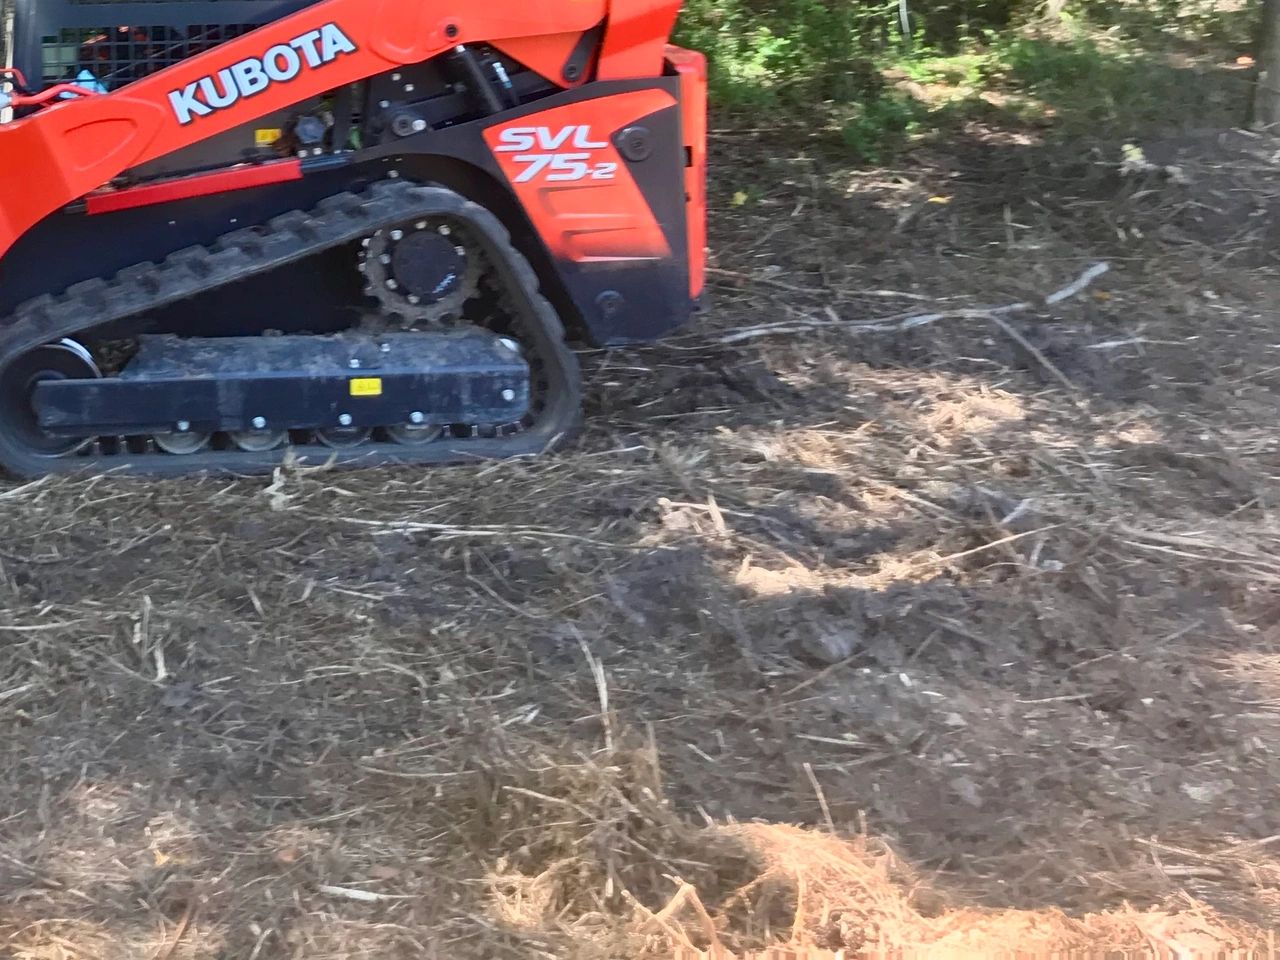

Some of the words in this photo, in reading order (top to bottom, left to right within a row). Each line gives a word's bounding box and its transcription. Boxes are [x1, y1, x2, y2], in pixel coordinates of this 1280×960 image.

[167, 22, 357, 125] KUBOTA
[494, 125, 609, 152] SVL
[512, 152, 618, 183] 75-2
